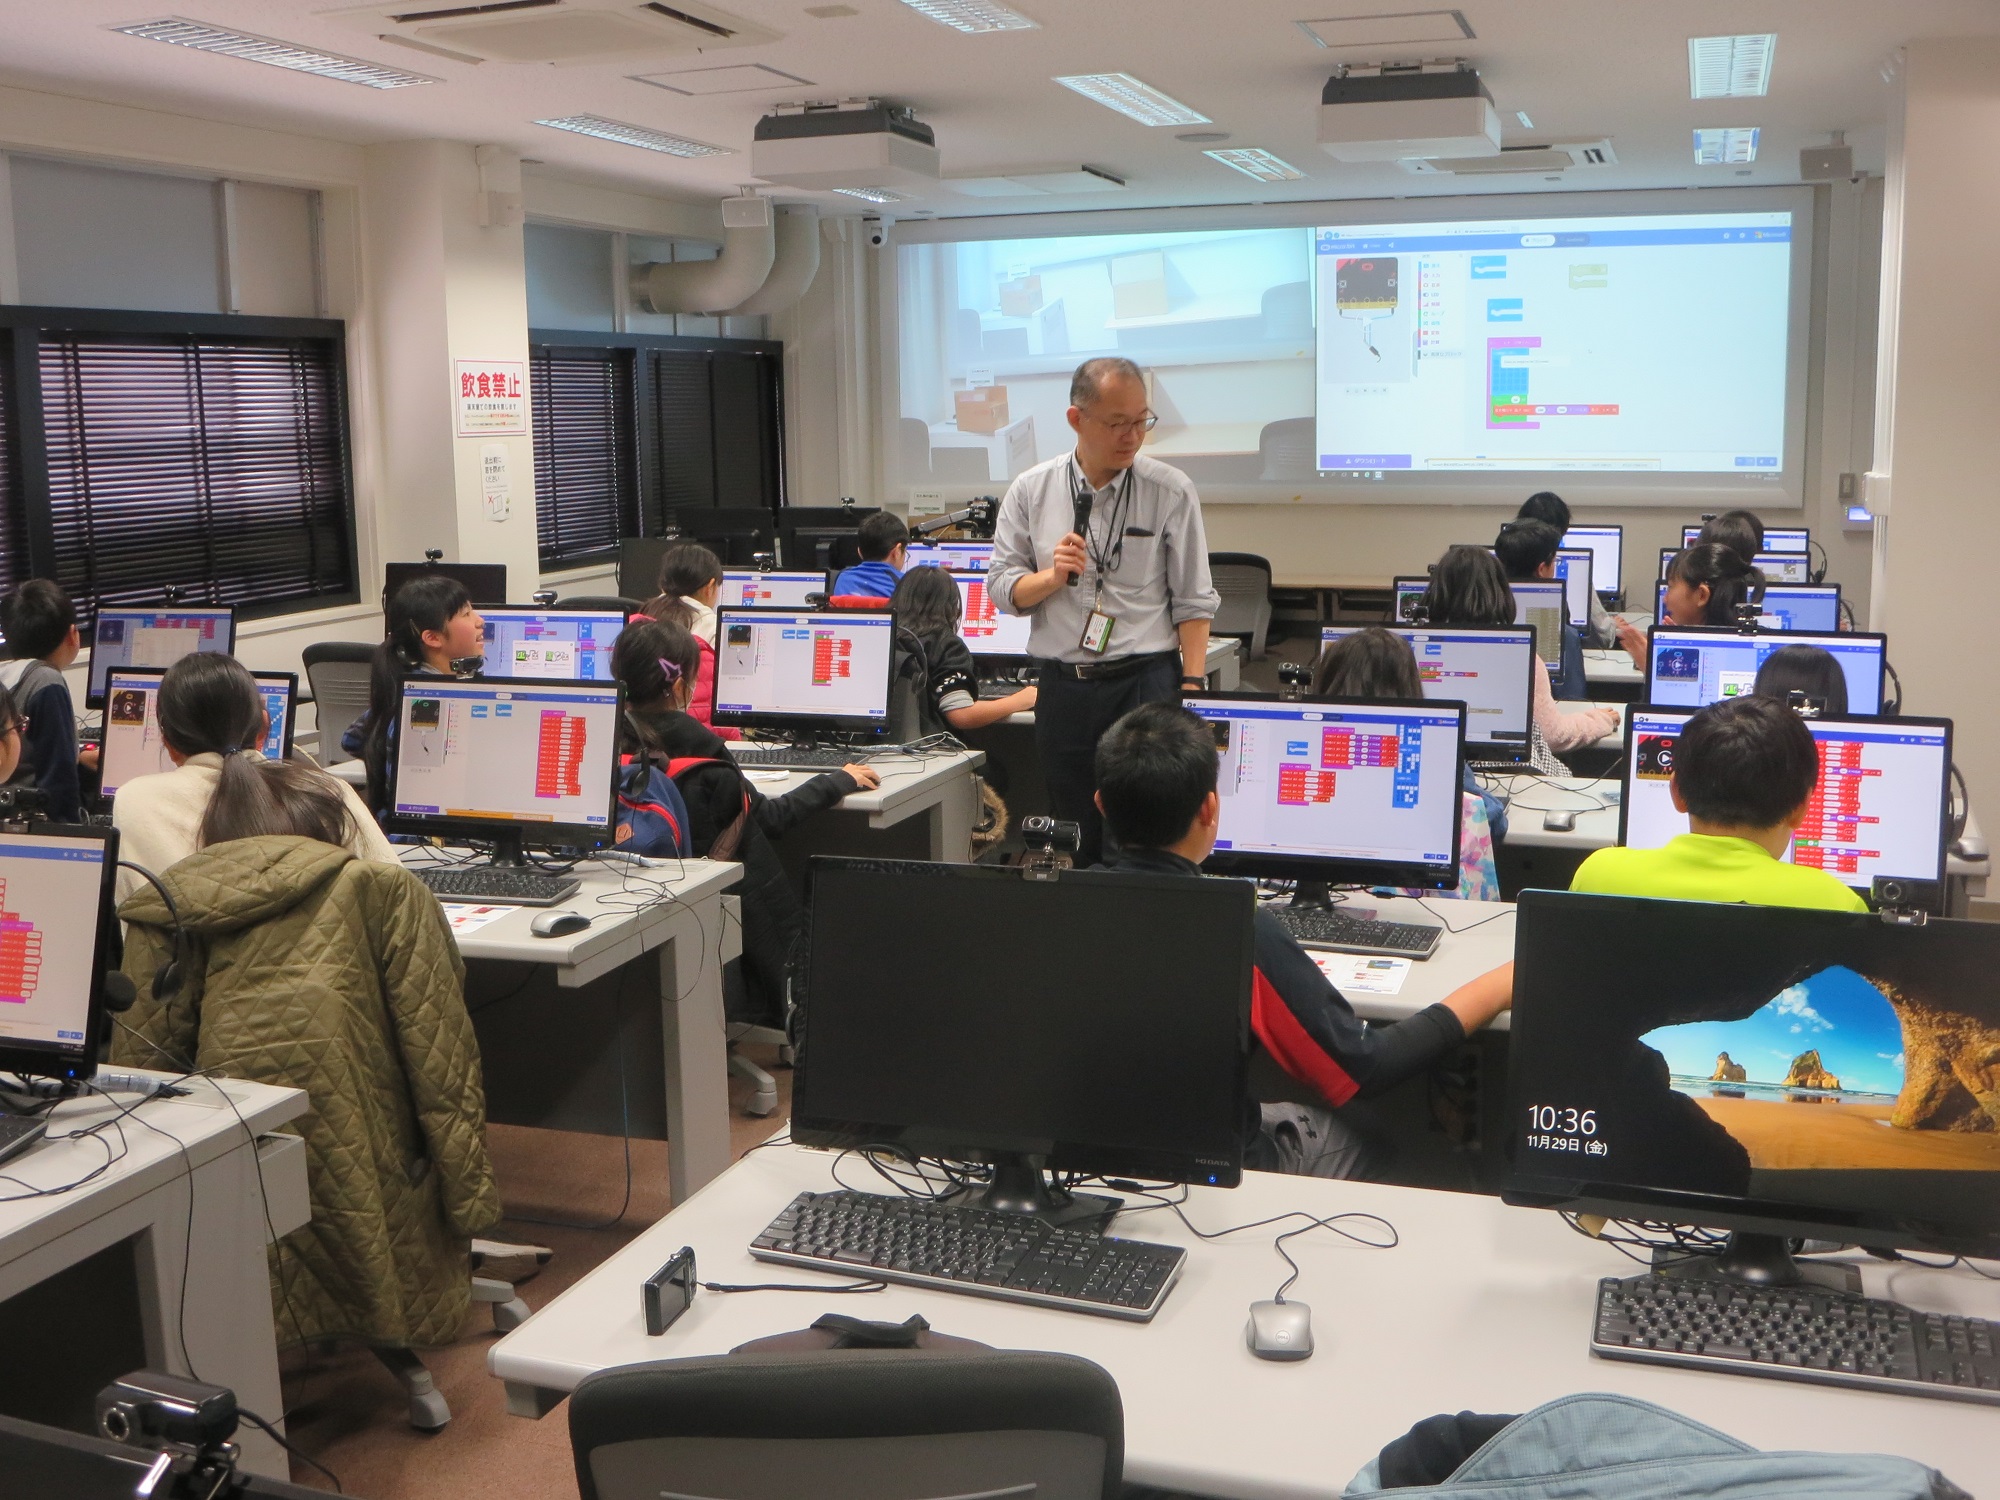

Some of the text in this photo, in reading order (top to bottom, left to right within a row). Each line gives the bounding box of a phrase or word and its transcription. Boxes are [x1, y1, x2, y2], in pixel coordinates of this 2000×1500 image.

[461, 371, 521, 398] 飲食禁止
[1528, 1104, 1597, 1135] 10:36
[1526, 1134, 1608, 1156] 11月29日 (金)
